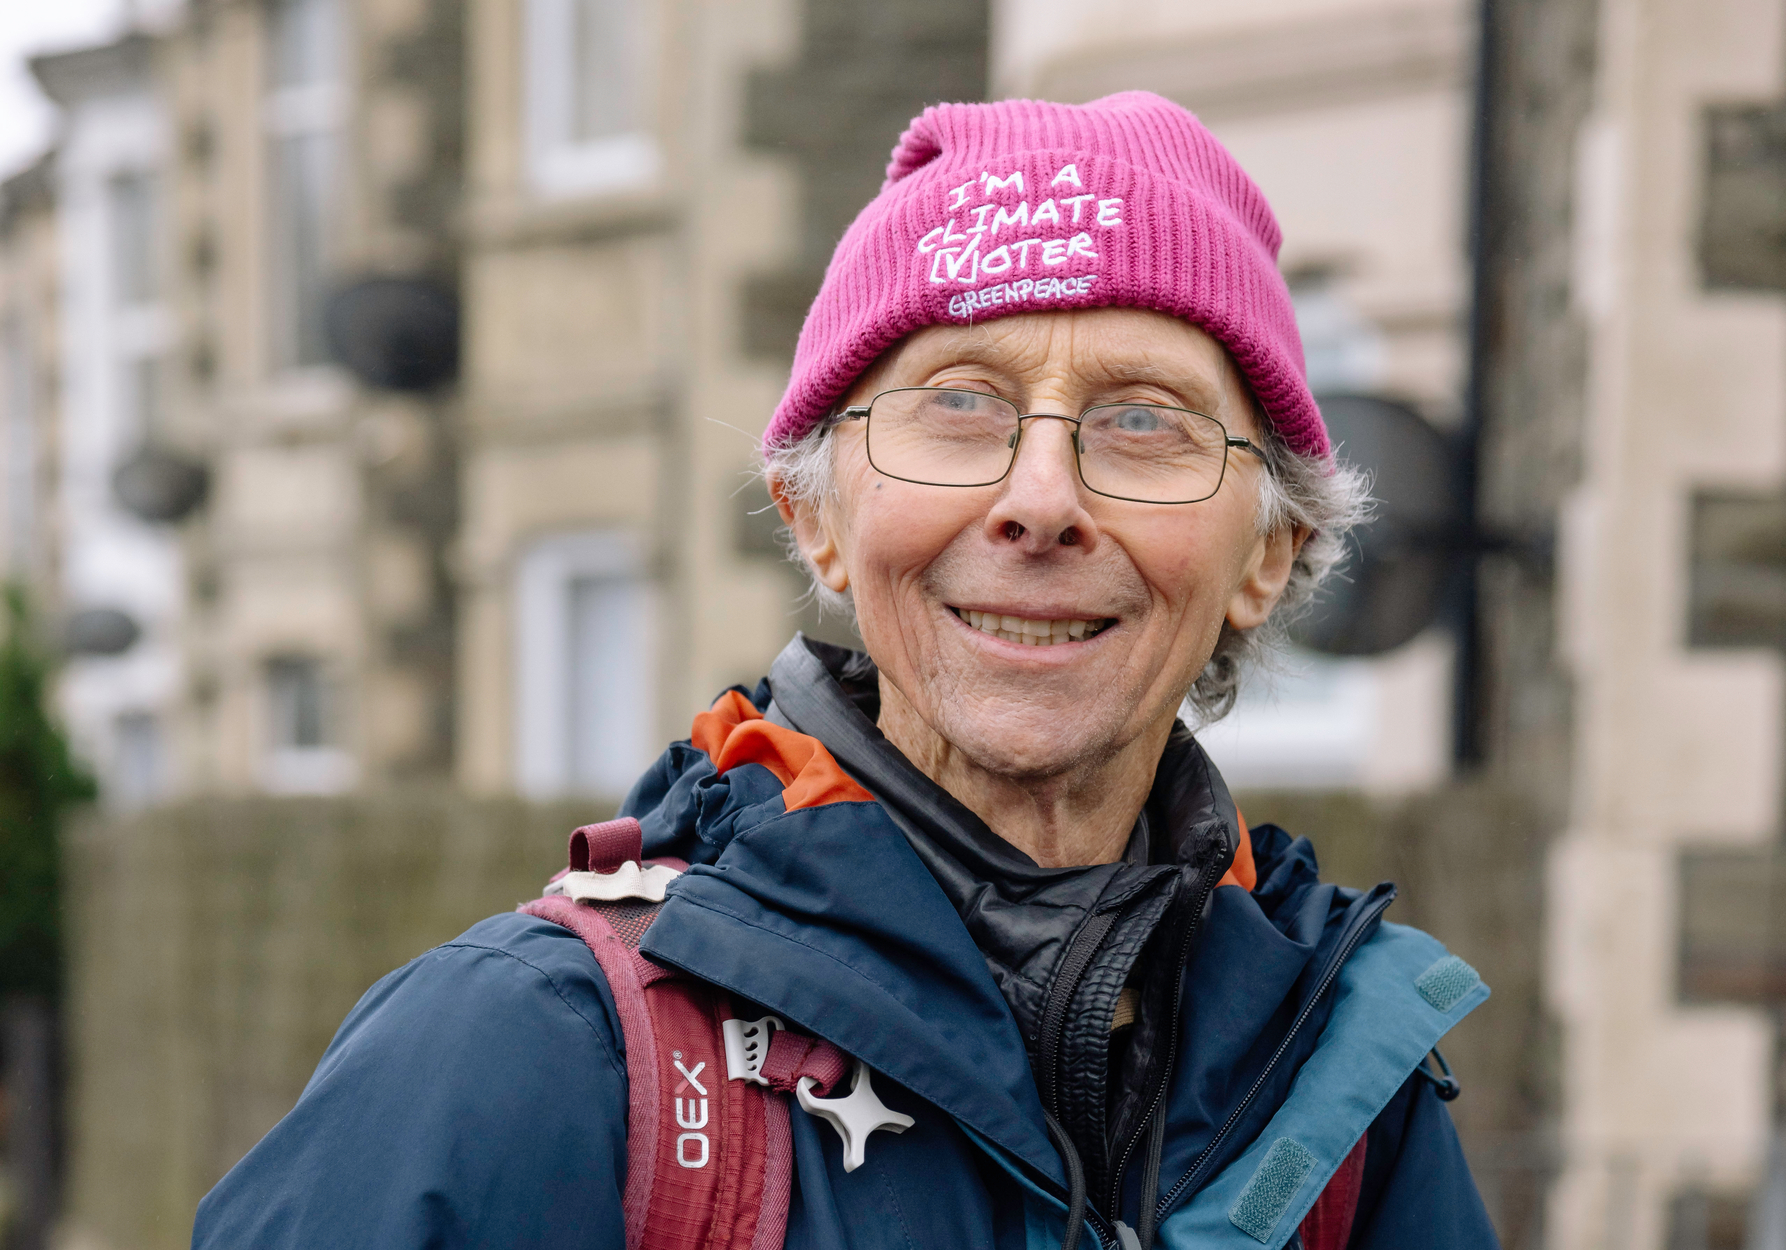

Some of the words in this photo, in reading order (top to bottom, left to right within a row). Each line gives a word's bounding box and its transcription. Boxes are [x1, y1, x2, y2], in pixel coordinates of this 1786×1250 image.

[949, 171, 1024, 211] I'M
[1051, 163, 1082, 188] A
[917, 194, 1124, 253] CLIMATE
[949, 274, 1099, 318] GREENPEACE
